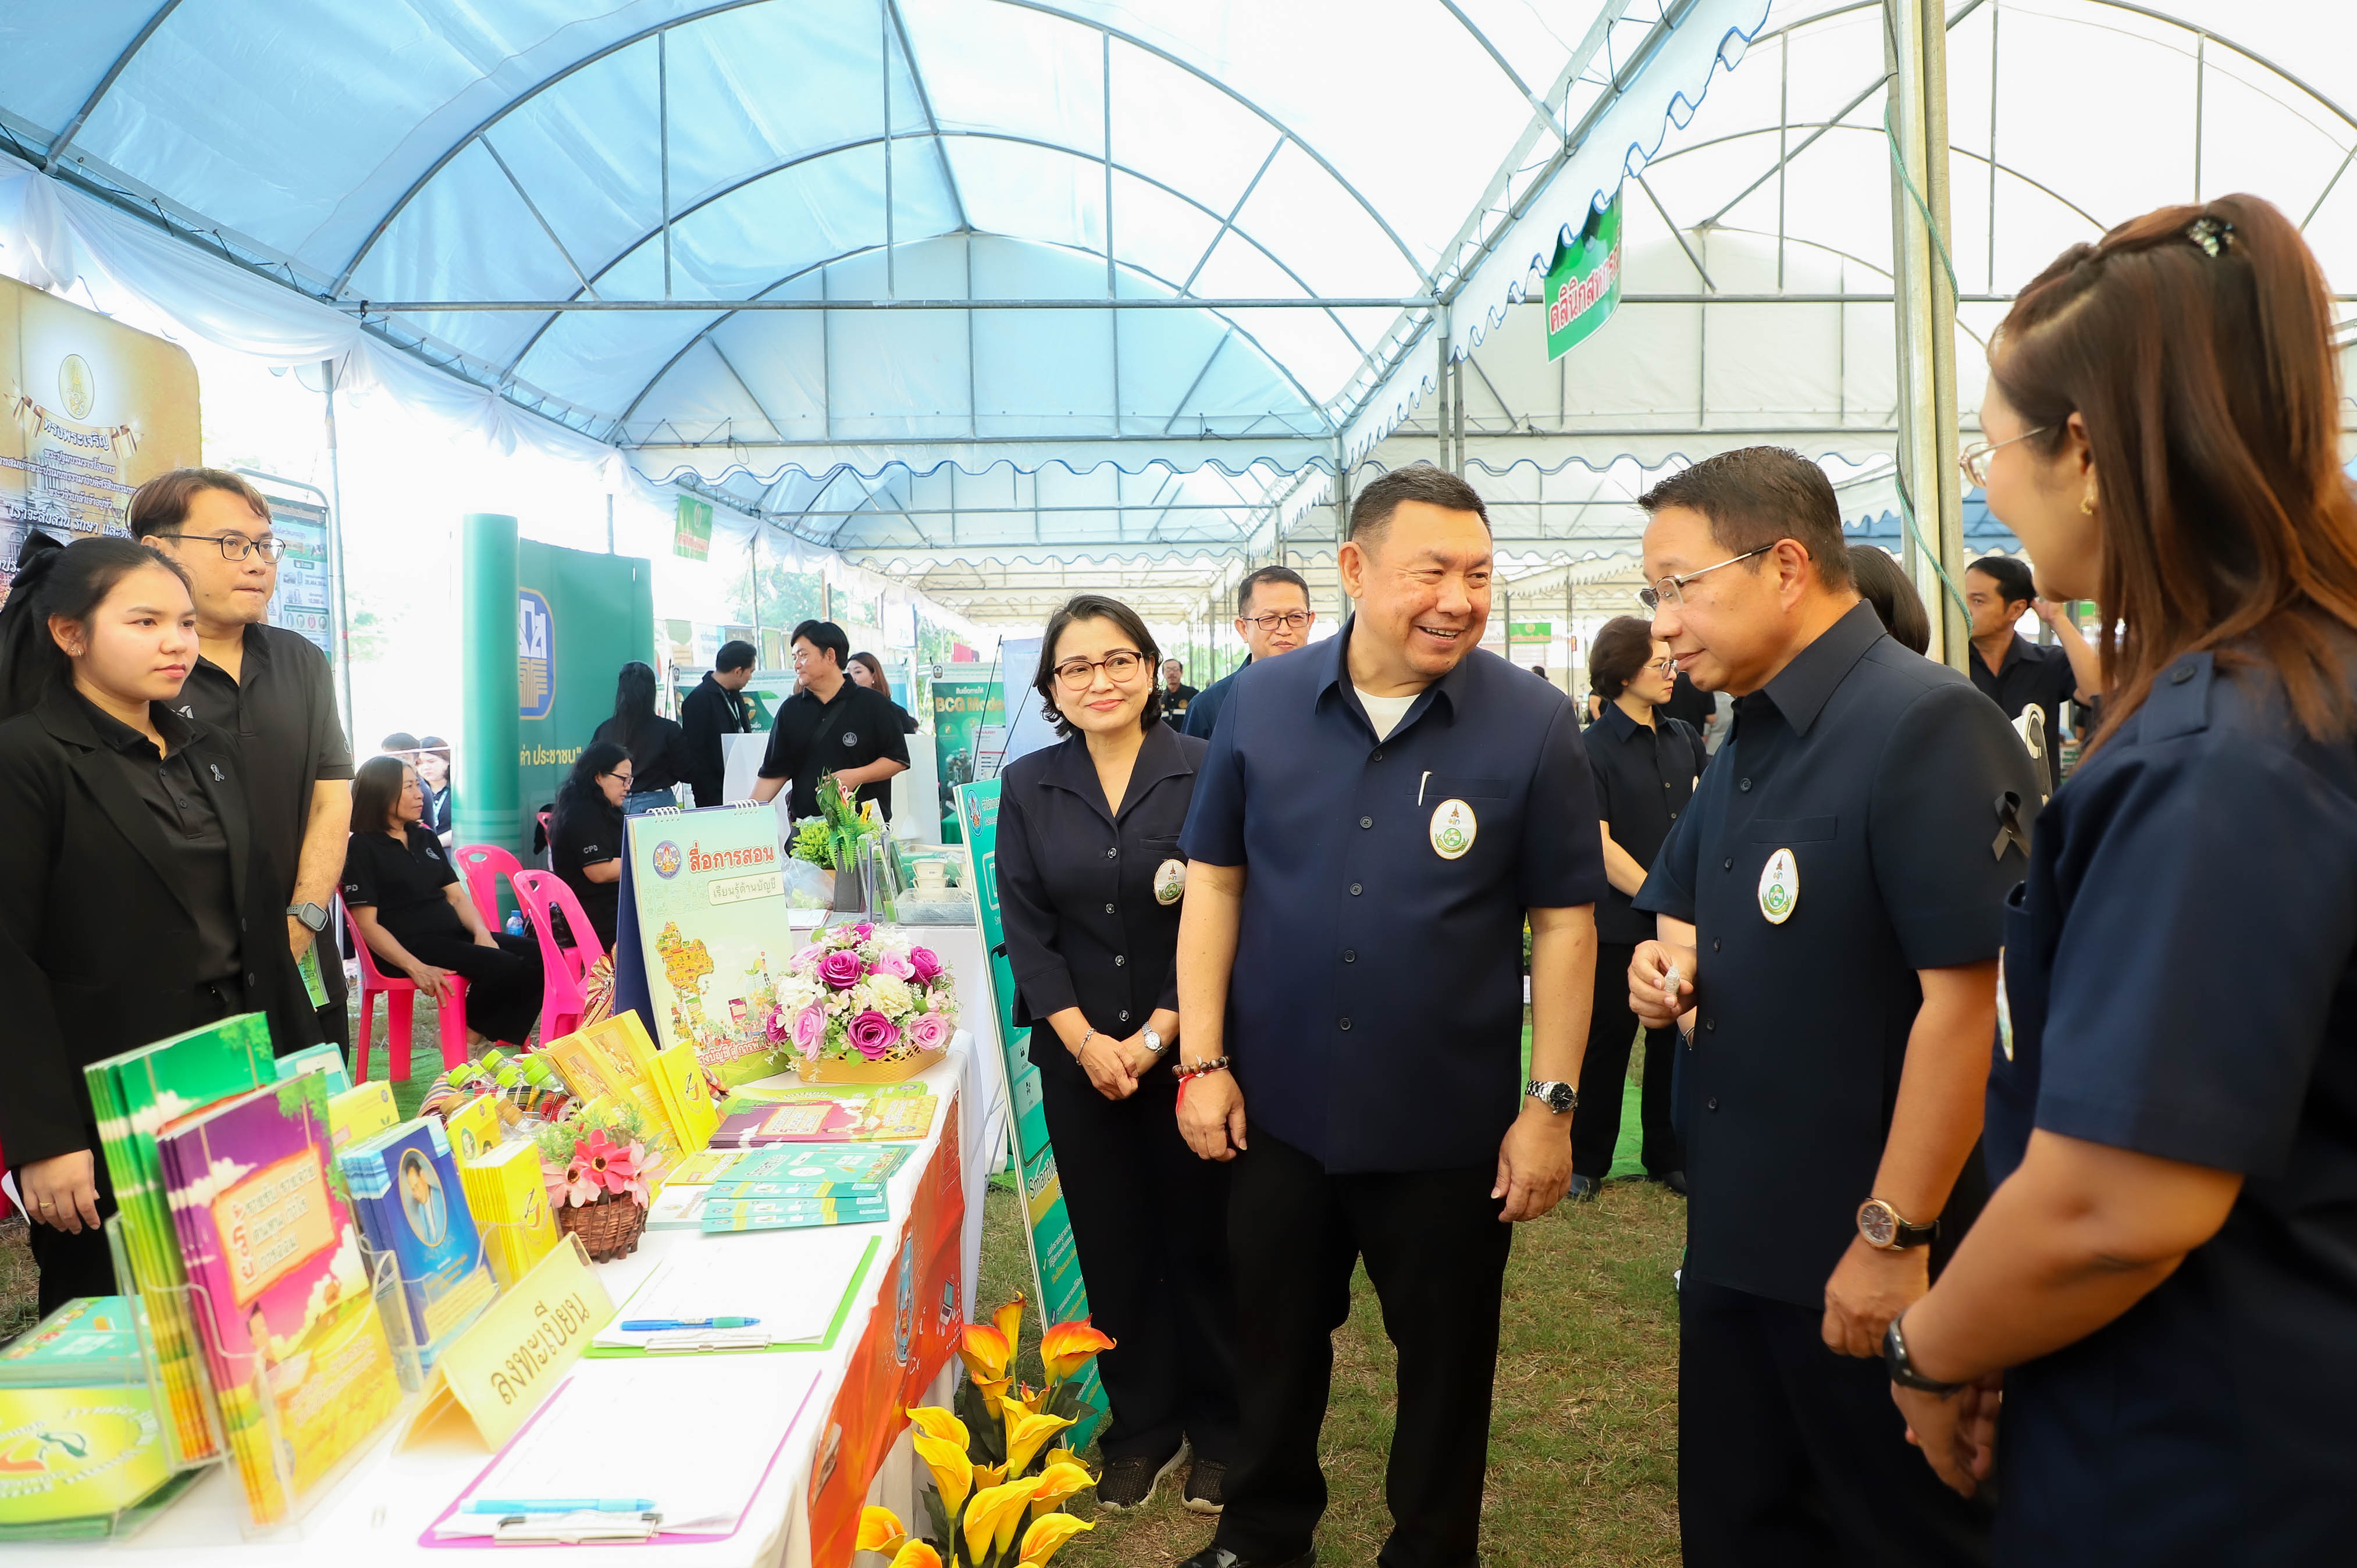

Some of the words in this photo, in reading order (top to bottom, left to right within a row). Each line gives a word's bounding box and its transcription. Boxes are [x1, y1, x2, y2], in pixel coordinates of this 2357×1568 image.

[43, 418, 109, 451] ทรงพระเจริญ
[74, 514, 99, 534] รักษา
[935, 697, 965, 712] BCG
[583, 844, 598, 854] CPD
[688, 841, 775, 872] สื่อการสอน
[344, 884, 358, 893] PD
[713, 877, 776, 899] เรียนรู้ด้านบัญชี
[698, 1046, 729, 1065] างบัญชี
[490, 1292, 590, 1406] ลงทะเบียน
